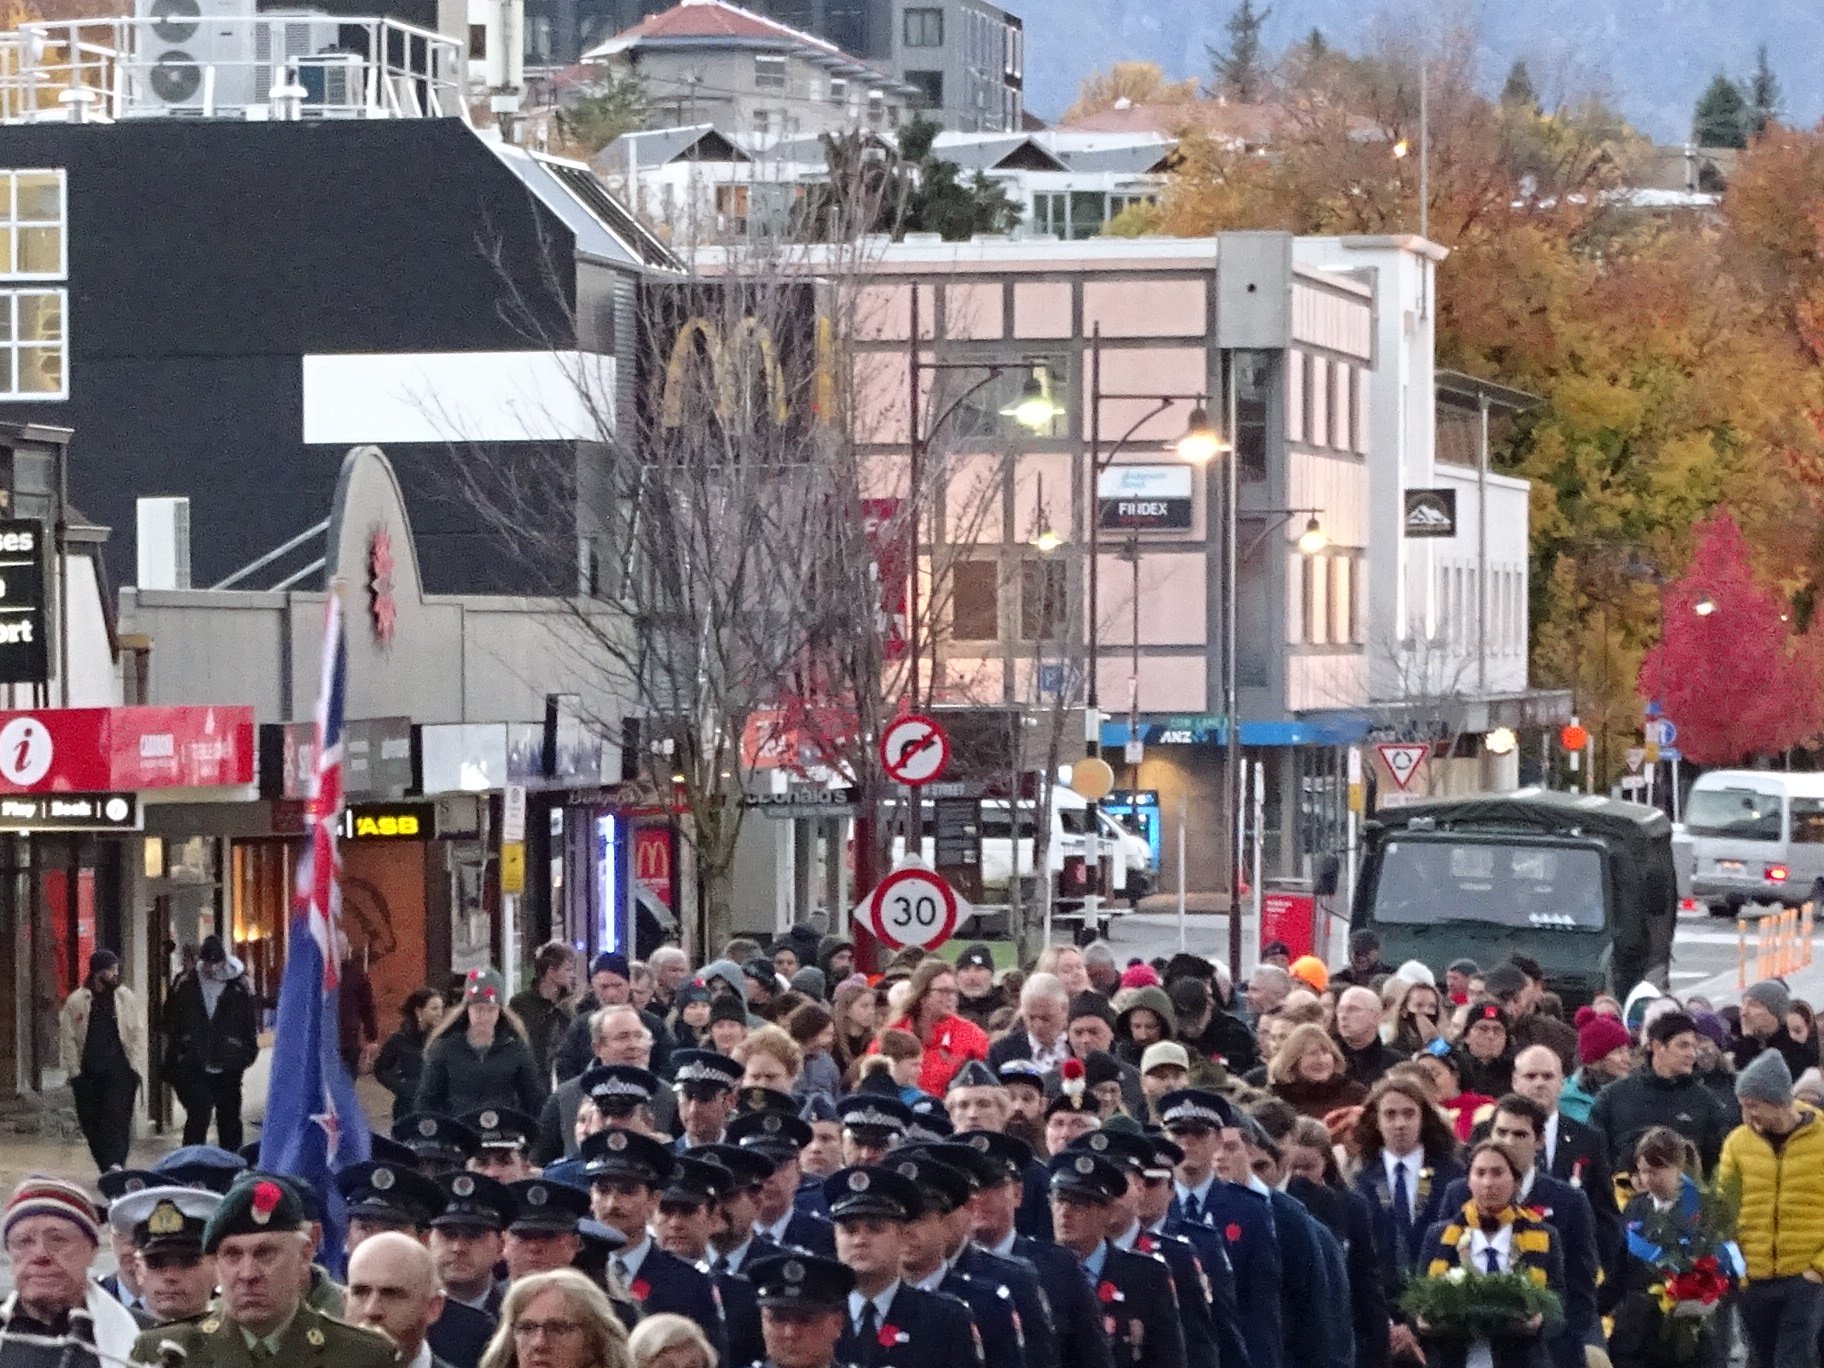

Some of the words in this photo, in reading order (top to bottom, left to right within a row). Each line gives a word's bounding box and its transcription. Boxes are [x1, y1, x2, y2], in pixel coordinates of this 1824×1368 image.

[1159, 731, 1192, 743] ANZ
[357, 816, 418, 835] ASB
[893, 896, 936, 926] 30
